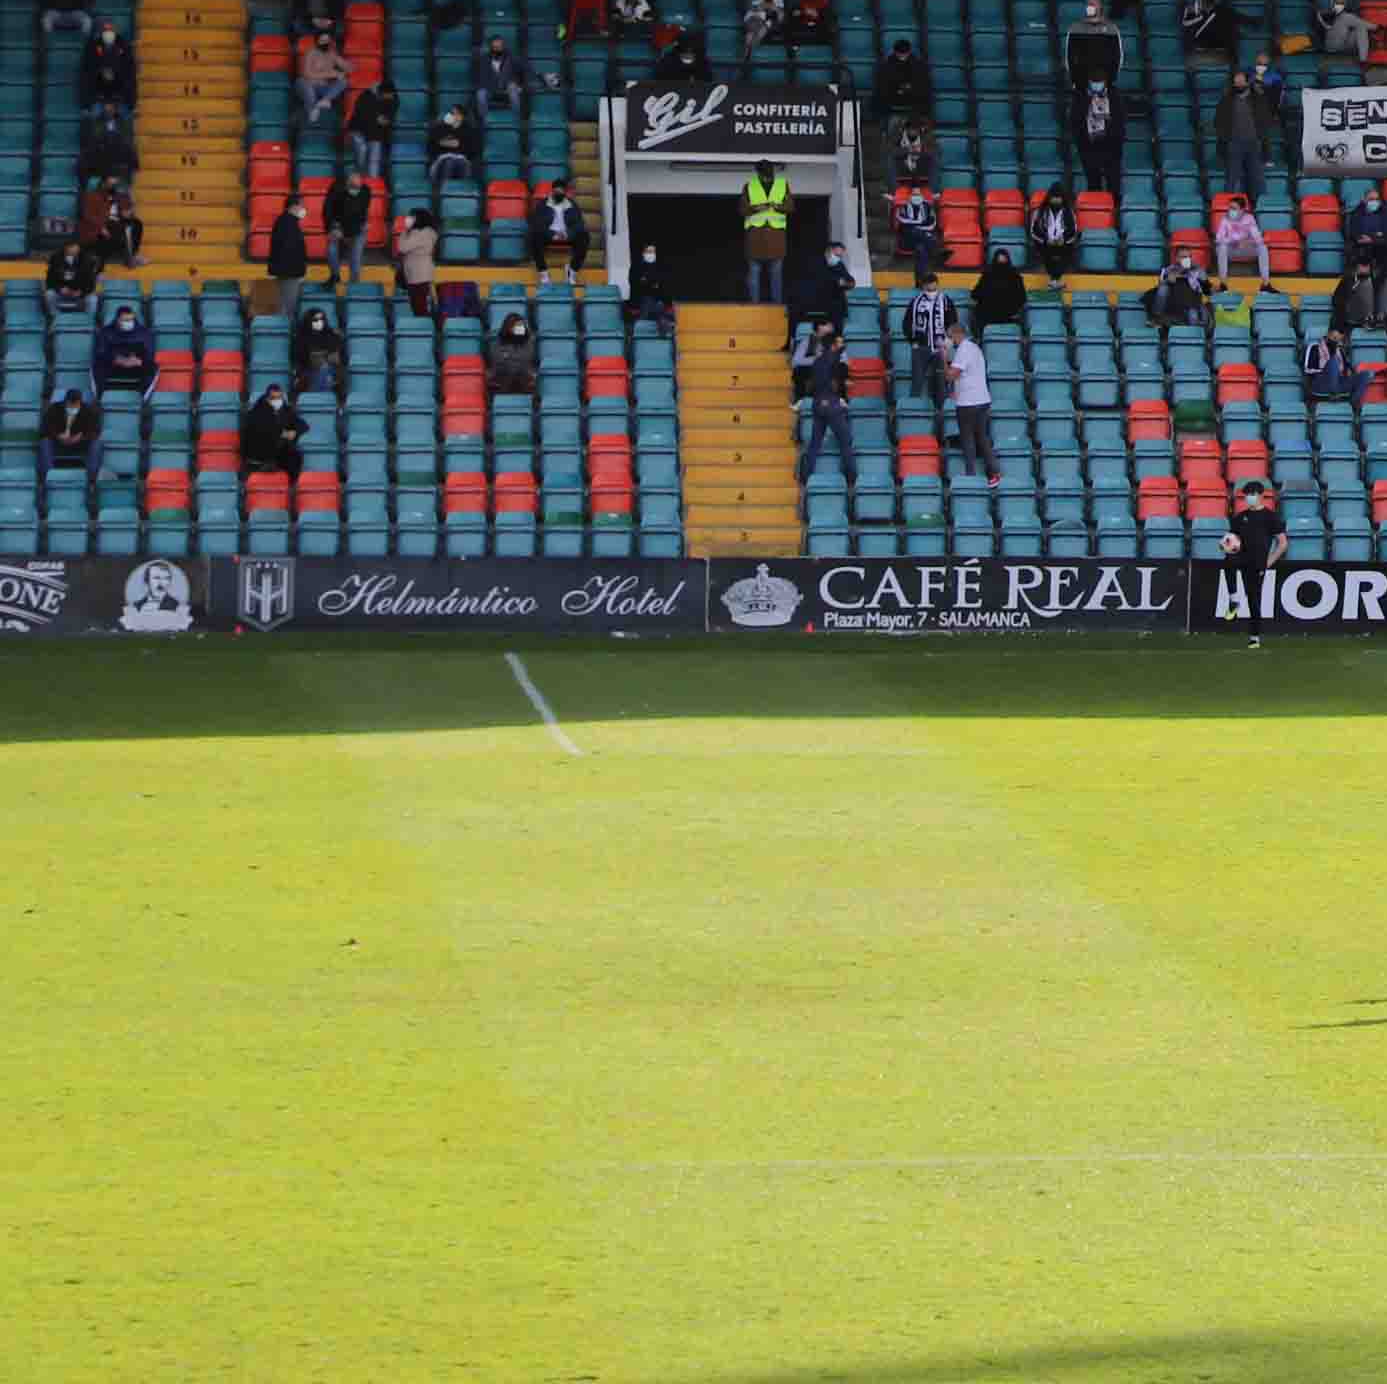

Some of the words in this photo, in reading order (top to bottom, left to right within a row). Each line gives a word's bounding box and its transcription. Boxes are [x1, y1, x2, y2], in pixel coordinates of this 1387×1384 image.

[643, 84, 728, 136] Gil
[733, 102, 828, 118] CONFITERÍA
[735, 120, 825, 135] PASTELERÍA
[318, 574, 538, 615] Helmántico
[561, 575, 685, 615] Hotel
[819, 558, 982, 609] CAFÉ
[1002, 566, 1174, 616] REAL
[824, 612, 863, 627] Plaza
[917, 612, 928, 626] 7
[939, 612, 1031, 627] SALAMANCA
